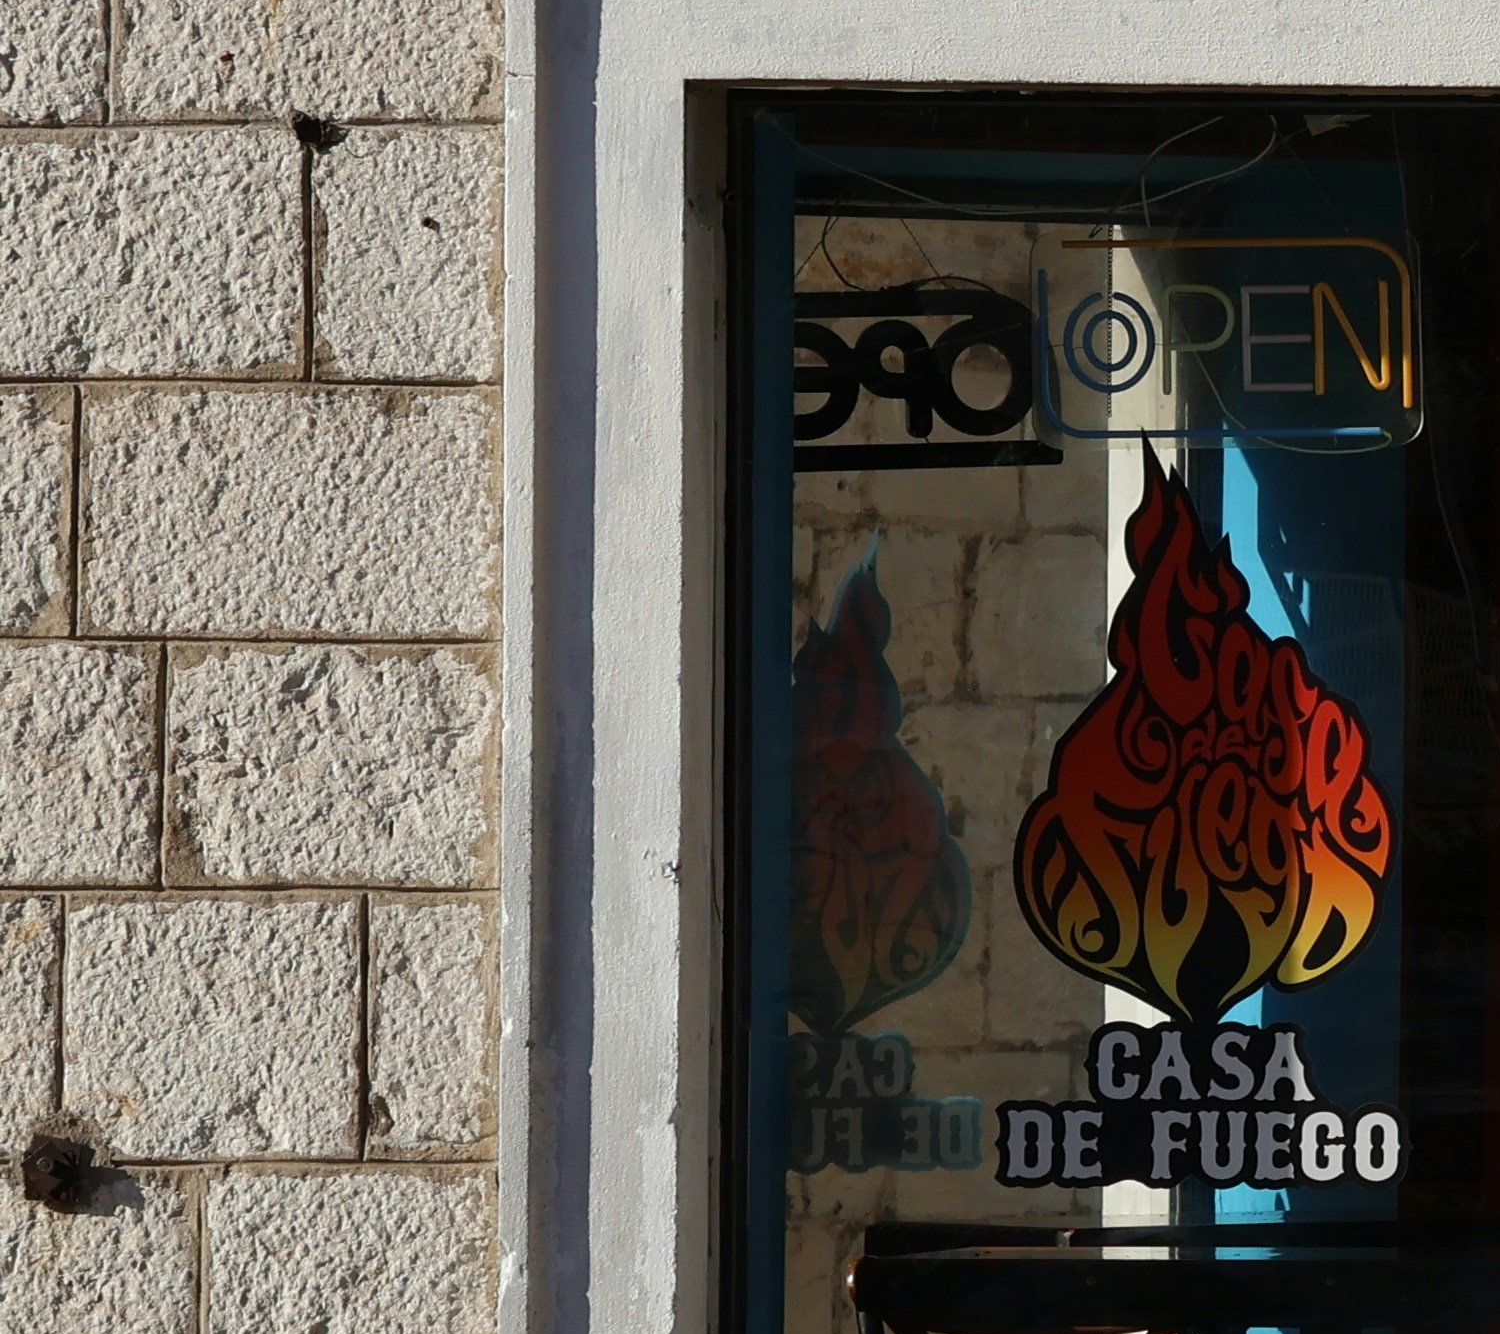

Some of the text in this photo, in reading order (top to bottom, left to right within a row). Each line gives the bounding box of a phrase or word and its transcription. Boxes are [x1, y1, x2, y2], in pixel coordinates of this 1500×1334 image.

[1062, 280, 1391, 397] OPEN
[1096, 1030, 1315, 1102] CASA
[1005, 1108, 1400, 1182] DE FUEGO
